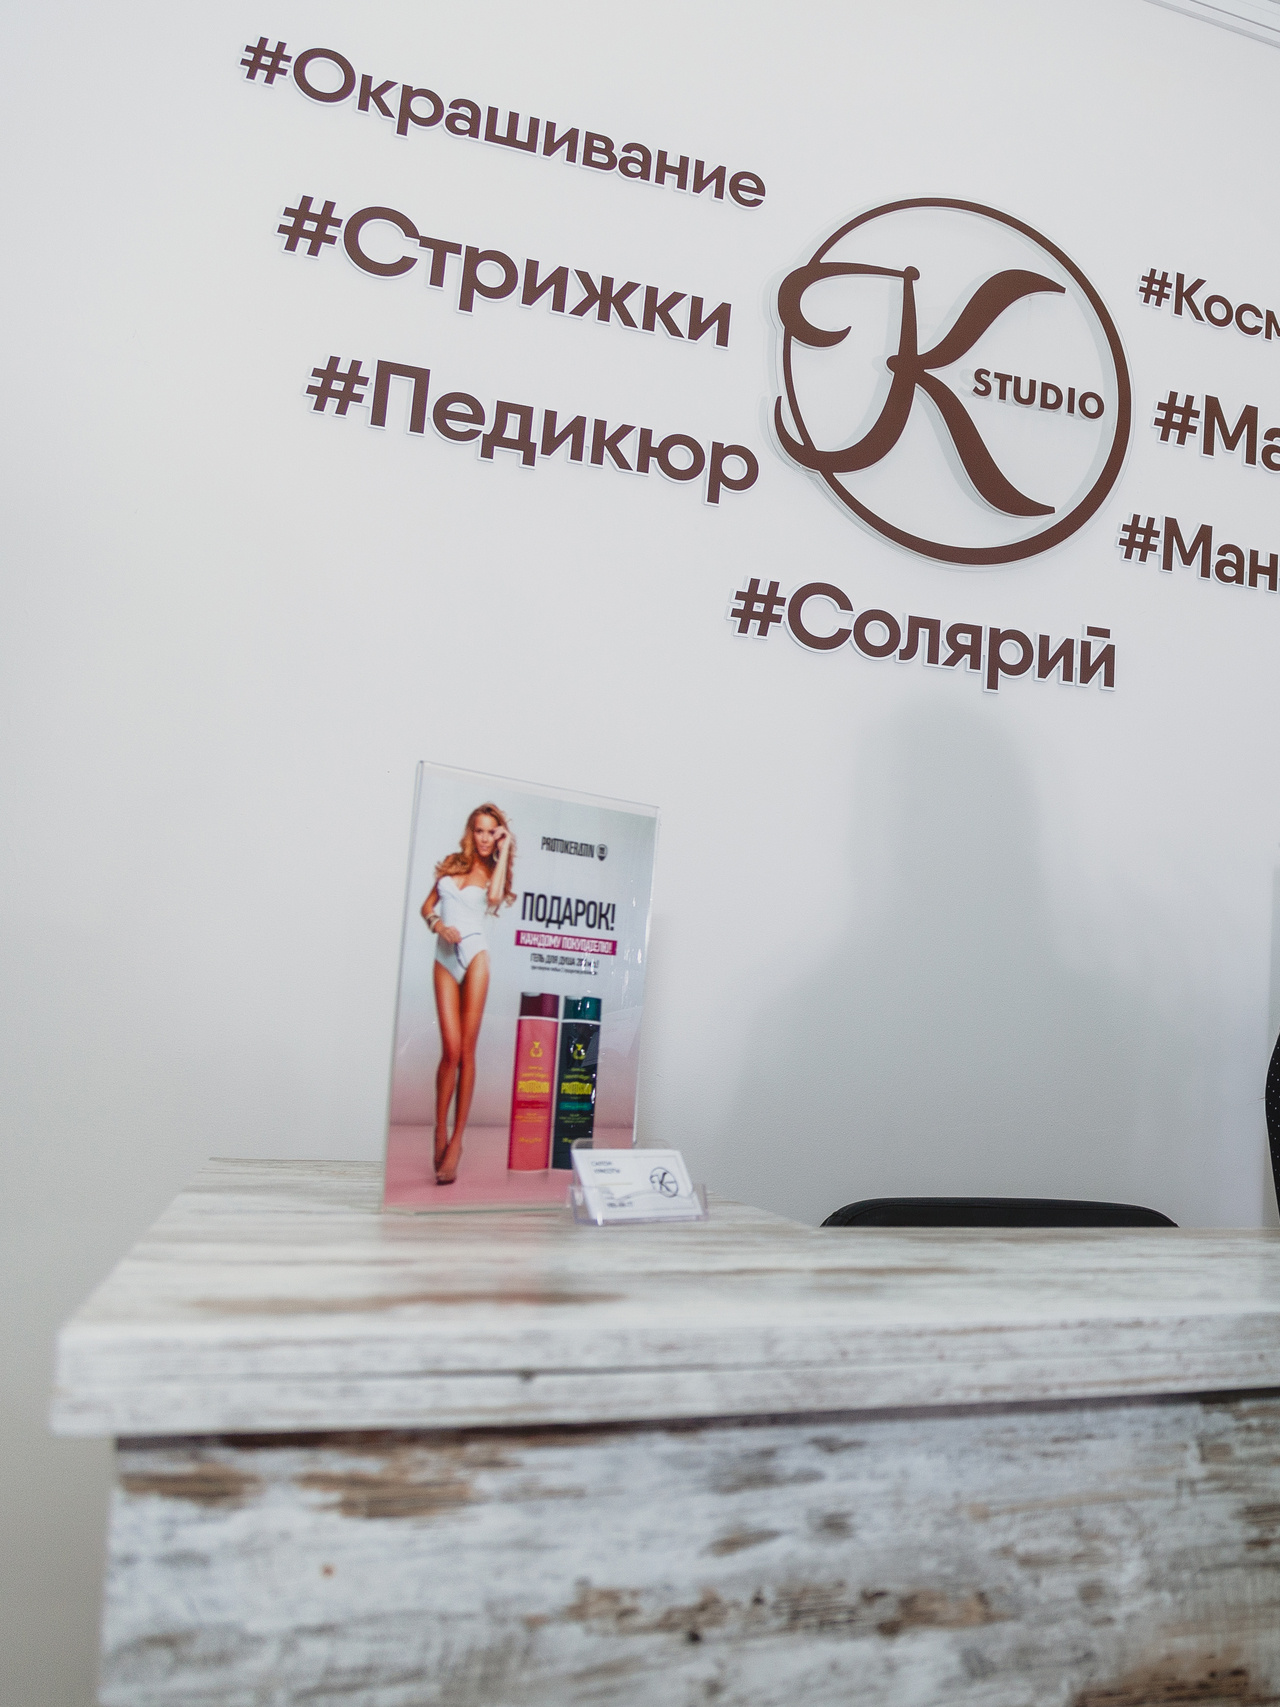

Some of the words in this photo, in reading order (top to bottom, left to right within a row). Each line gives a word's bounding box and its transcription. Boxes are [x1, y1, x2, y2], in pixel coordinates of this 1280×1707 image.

[239, 36, 766, 208] #Окрашивание
[276, 195, 732, 348] #Стрижки
[305, 355, 759, 505] #Педикюр
[972, 368, 1105, 420] STUDIO
[730, 577, 1116, 691] #Солярий
[520, 931, 561, 949] КАЖДОМУ
[561, 936, 613, 954] ПОКУПАТЕЛЮ!
[521, 891, 616, 931] ПОДАРОК!
